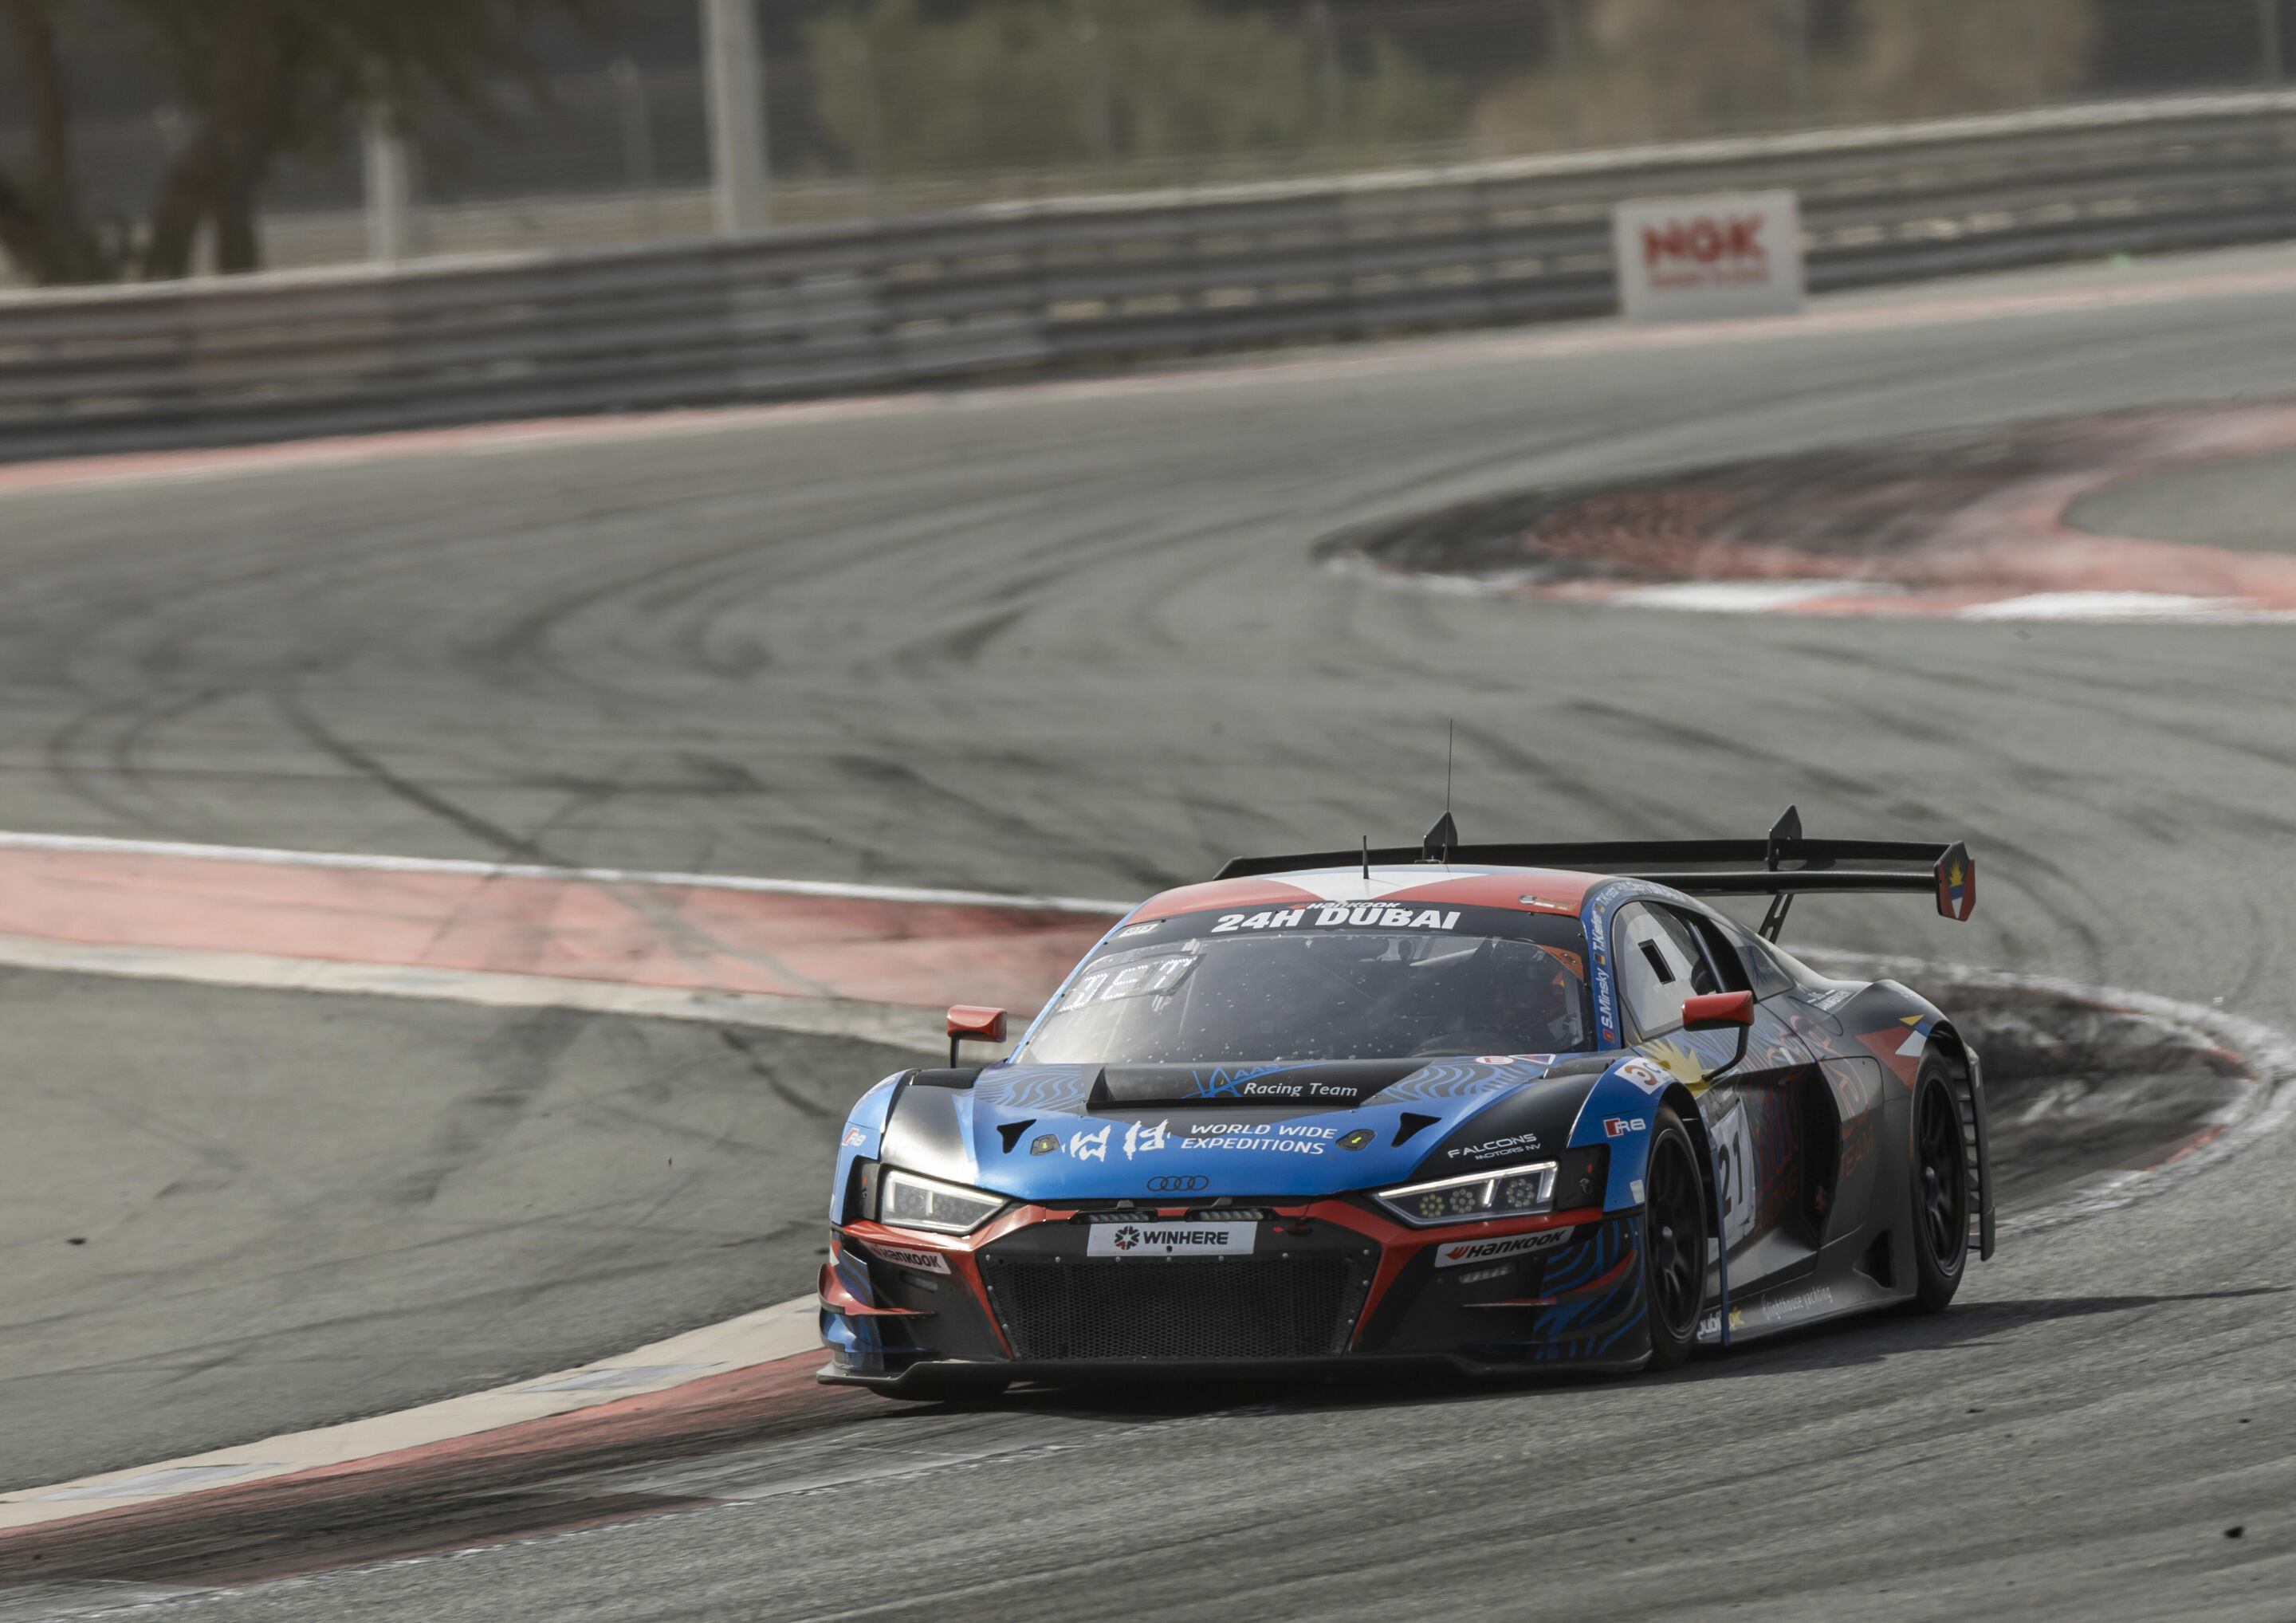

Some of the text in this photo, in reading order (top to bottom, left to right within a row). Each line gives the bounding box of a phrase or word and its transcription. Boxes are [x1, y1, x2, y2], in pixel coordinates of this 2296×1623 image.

[1211, 906, 1461, 933] 24H DUBAI
[1596, 967, 1614, 1029] S.Minsky
[1244, 1083, 1358, 1097] Racing Team
[1190, 1124, 1338, 1139] WORLD WIDE
[1613, 1118, 1646, 1134] R8
[1181, 1138, 1327, 1155] EXPEDITIONS
[1448, 1133, 1537, 1158] FALCONS
[1475, 1142, 1541, 1161] MOTORS NV
[1718, 1130, 1744, 1219] 21
[1143, 1230, 1229, 1245] WINHERE
